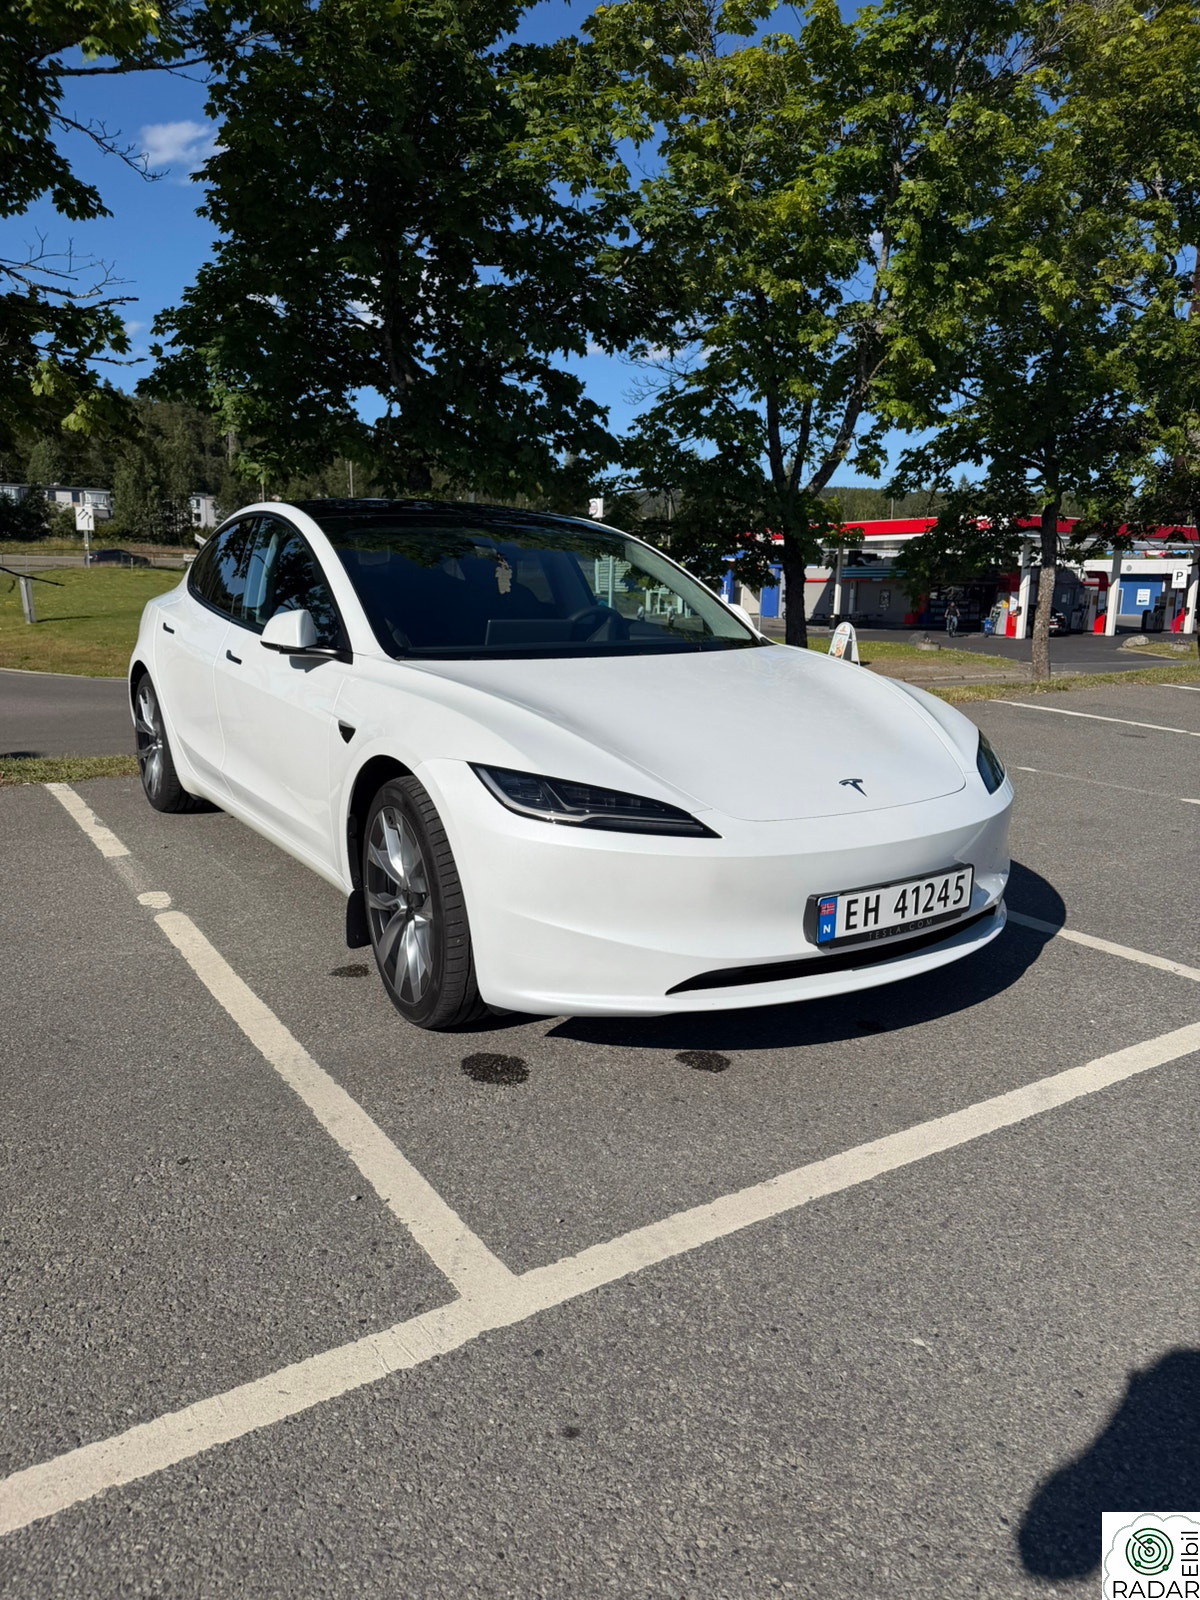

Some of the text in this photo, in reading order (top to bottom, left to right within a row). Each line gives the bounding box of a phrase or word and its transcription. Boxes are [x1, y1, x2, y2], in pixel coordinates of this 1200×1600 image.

[1176, 571, 1183, 580] P
[845, 874, 965, 931] EH 41245
[823, 924, 831, 934] N
[868, 919, 933, 940] TESLA.COM
